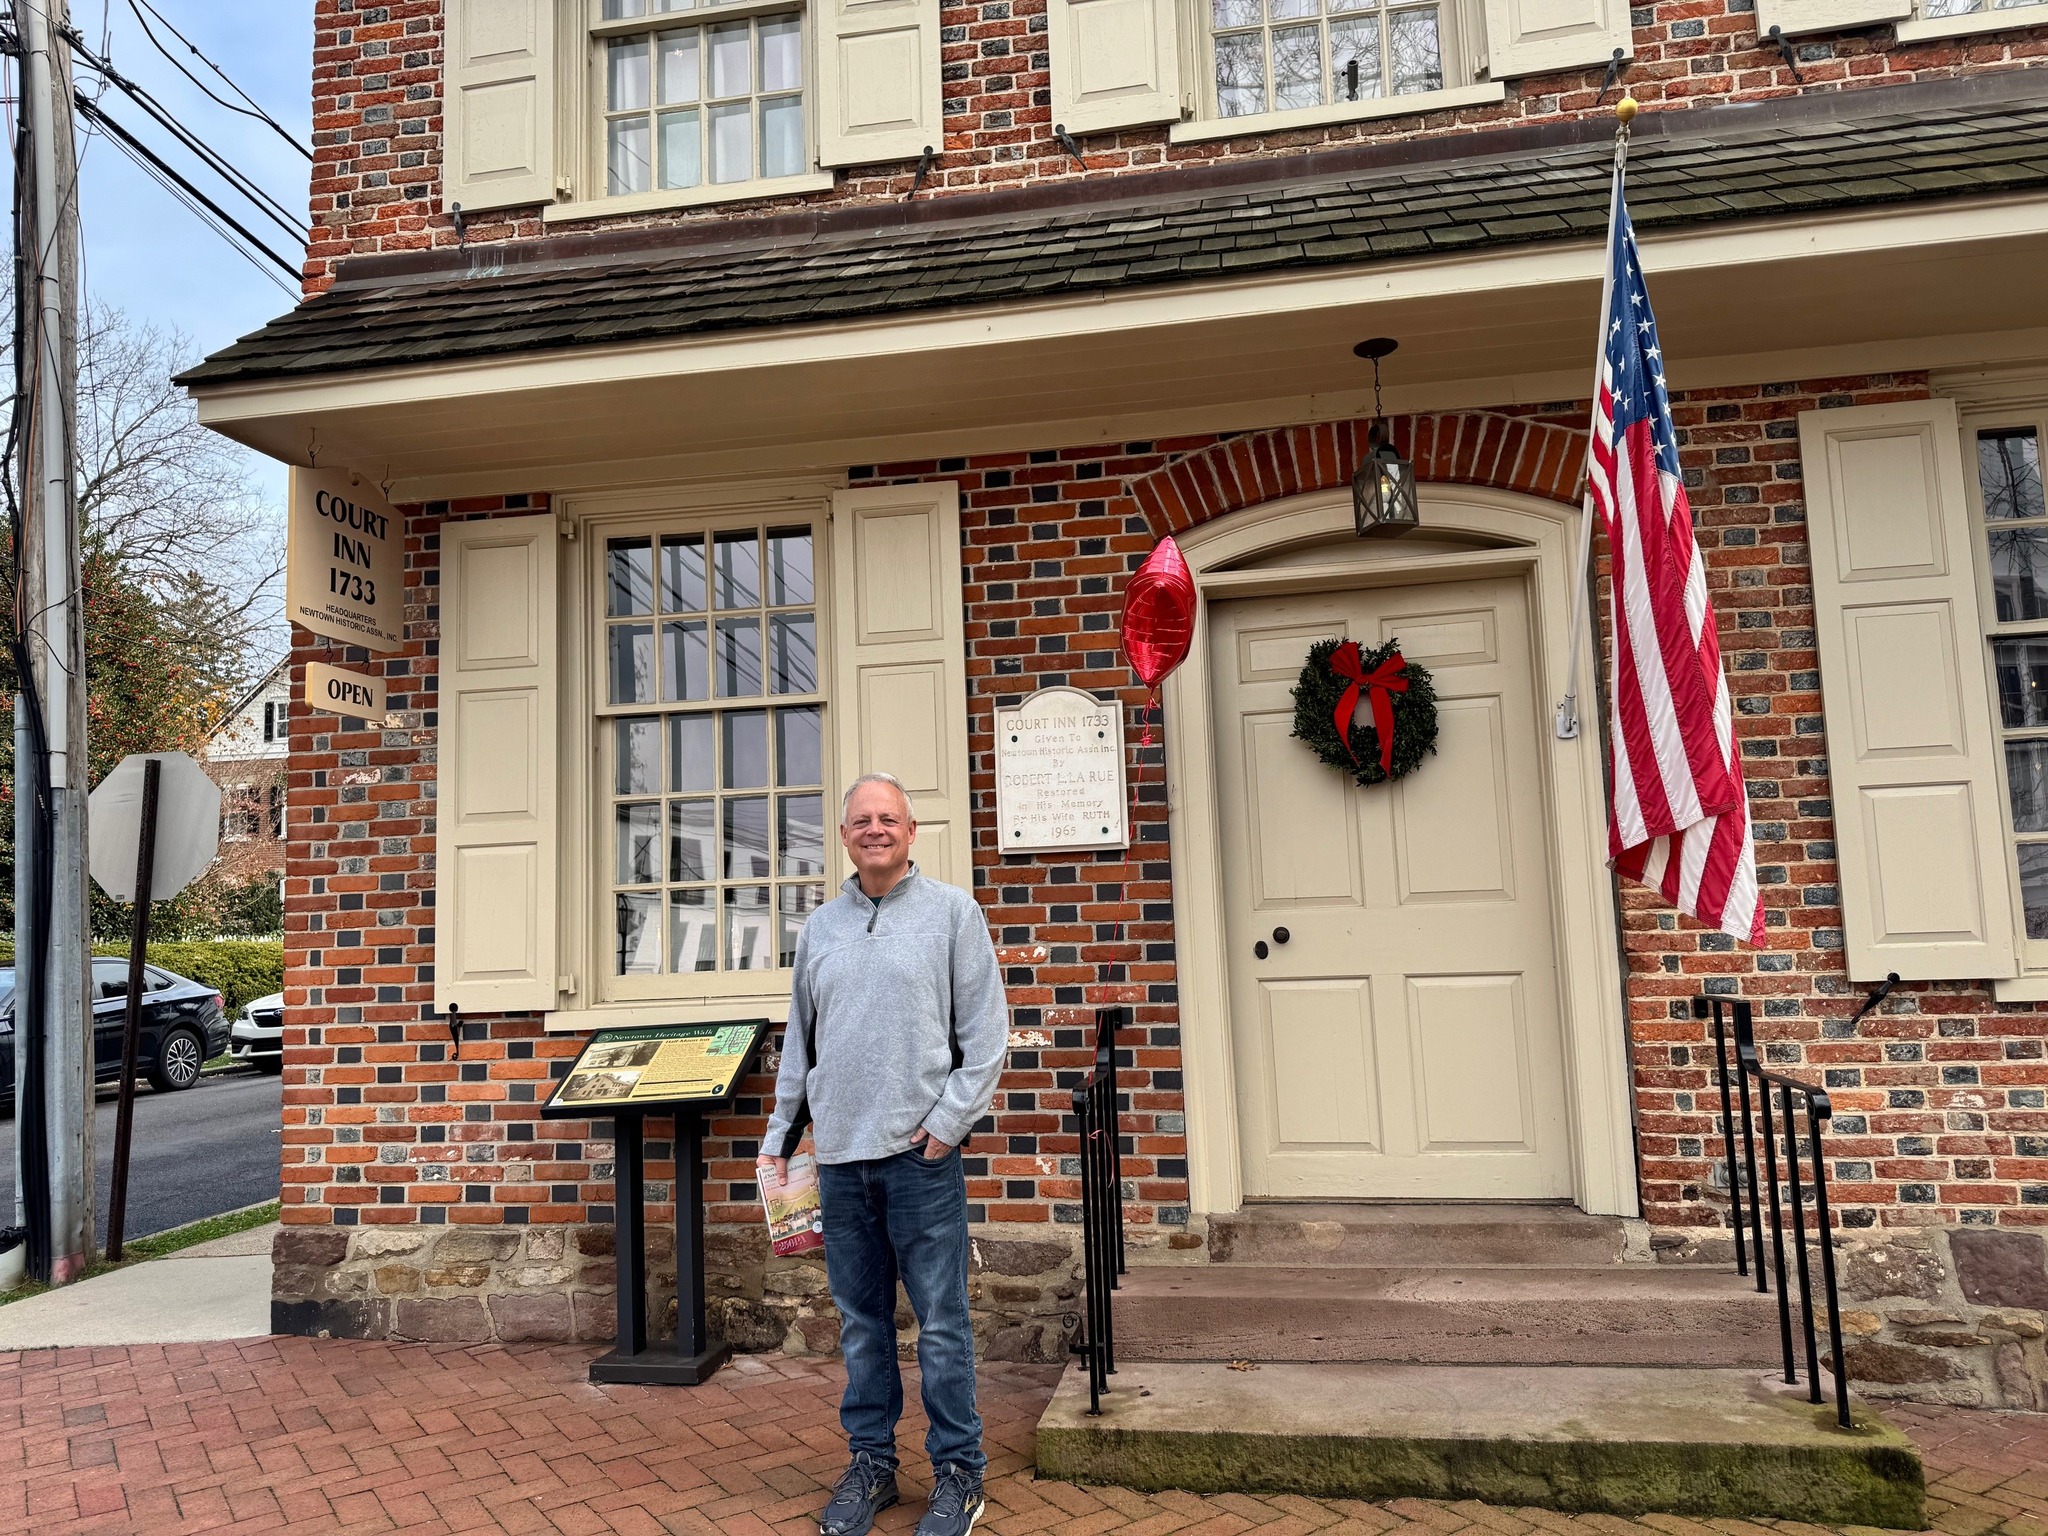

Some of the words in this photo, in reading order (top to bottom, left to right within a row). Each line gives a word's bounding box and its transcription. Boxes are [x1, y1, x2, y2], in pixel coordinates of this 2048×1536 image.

[316, 490, 389, 541] COURT
[333, 532, 371, 569] INN
[329, 567, 376, 605] 1733
[325, 603, 377, 626] HEADQUARTERS
[299, 605, 335, 623] NEWTOWN
[335, 617, 366, 632] HISTORIC
[386, 632, 399, 643] INC.
[327, 678, 373, 708] OPEN
[1006, 718, 1049, 731] COURT
[1053, 716, 1077, 729] INN
[1082, 714, 1109, 728] 1733
[1034, 734, 1065, 744] Given
[1069, 733, 1081, 742] To
[1001, 748, 1038, 758] Newtown
[1039, 746, 1074, 756] Historic
[1100, 744, 1117, 753] Inc.
[1052, 758, 1065, 768] By
[1004, 773, 1052, 788] ROBERT
[1089, 770, 1115, 783] RUE
[1036, 788, 1086, 797] Restored
[1036, 801, 1053, 810] His
[1061, 799, 1103, 809] Memory
[1030, 813, 1047, 823] His
[1051, 813, 1075, 822] Wife
[1082, 810, 1110, 820] RUTH
[1050, 824, 1077, 839] 1965
[612, 1033, 652, 1041] Newtown
[654, 1031, 691, 1039] Heritage
[693, 1028, 714, 1036] Walk
